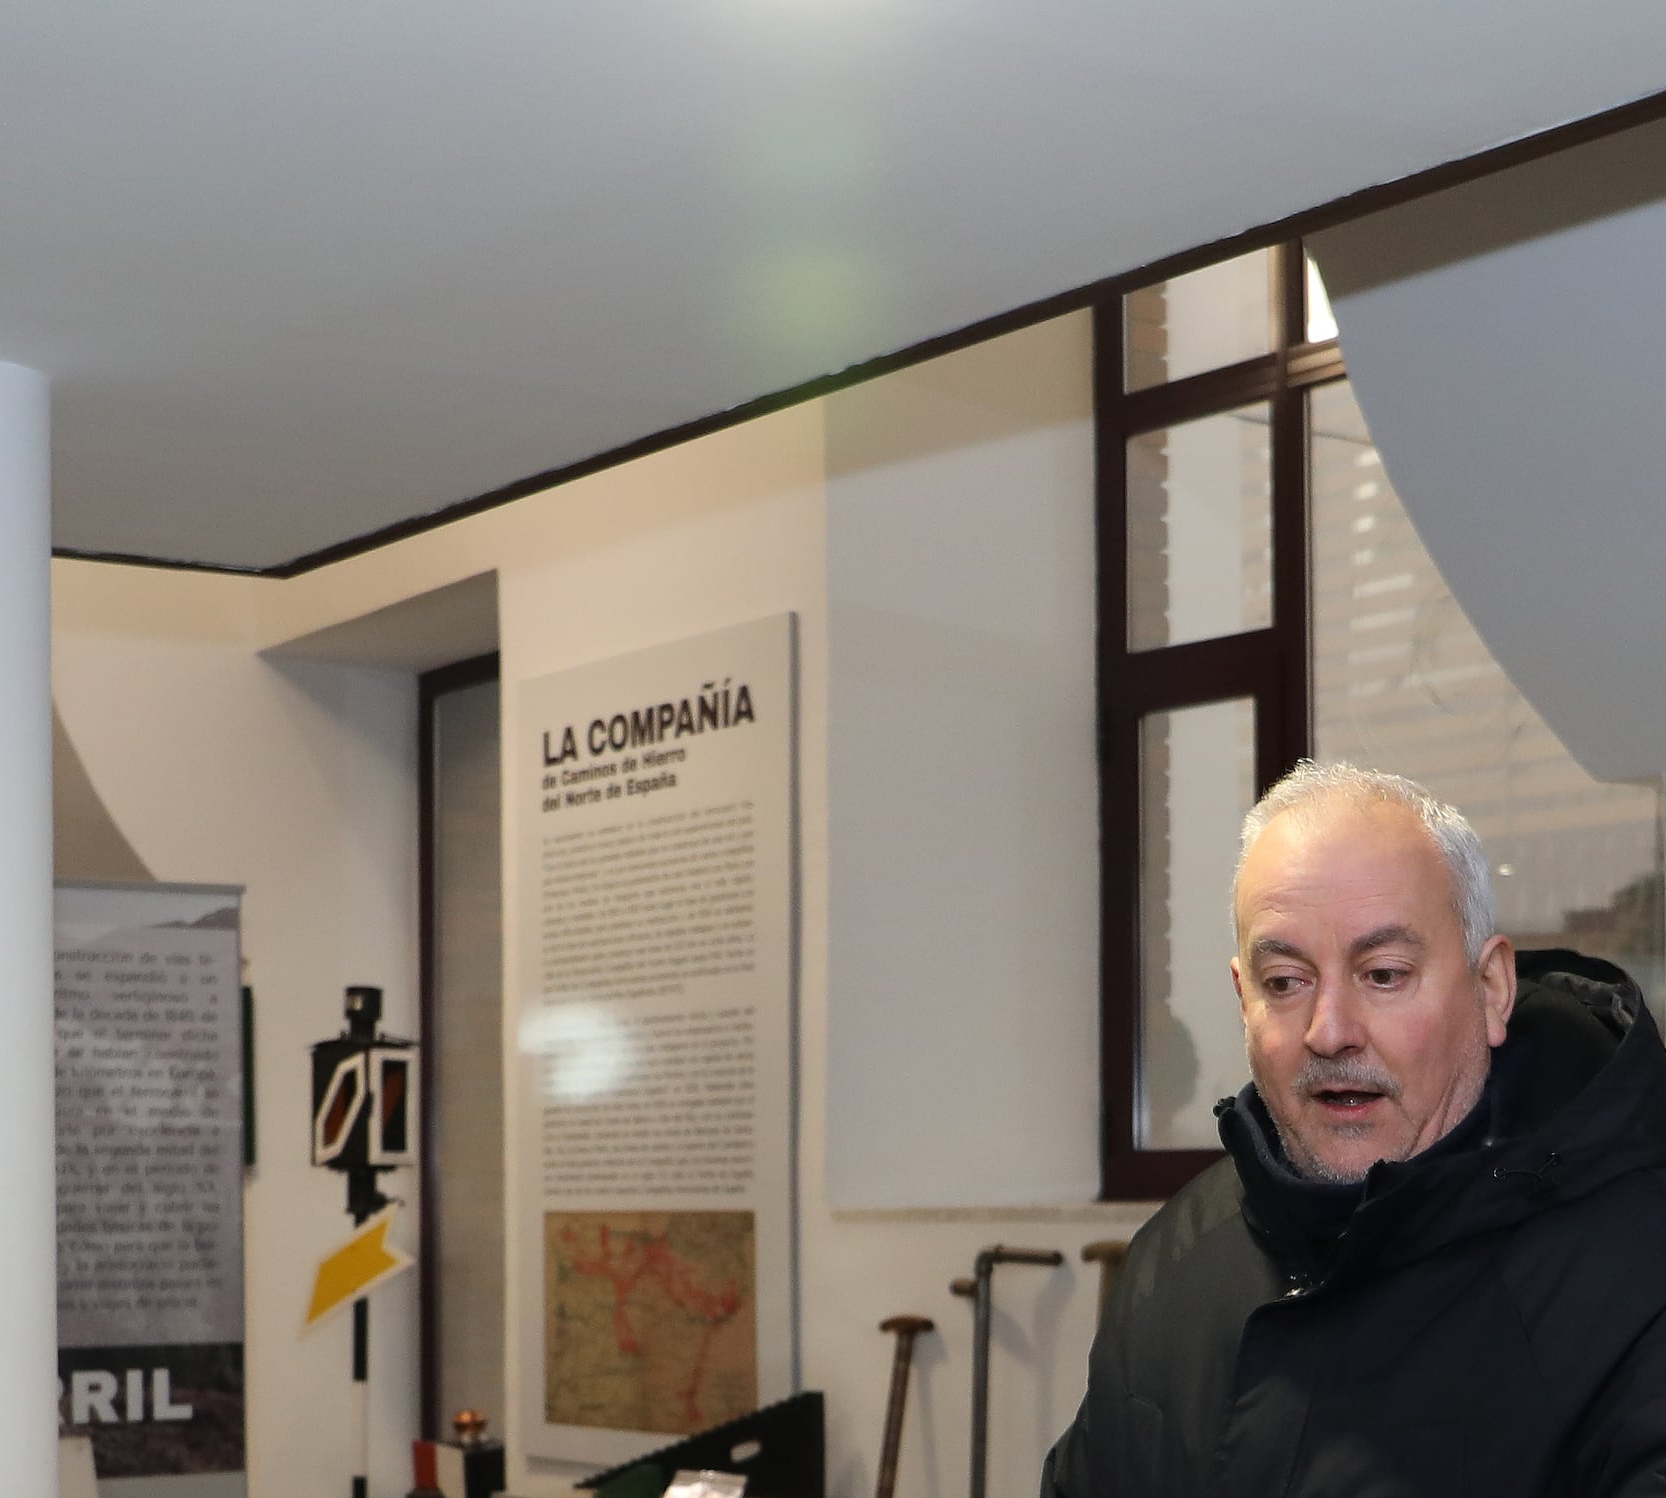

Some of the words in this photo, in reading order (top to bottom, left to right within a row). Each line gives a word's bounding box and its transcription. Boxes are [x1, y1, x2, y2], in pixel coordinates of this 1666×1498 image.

[543, 727, 578, 767] LA
[587, 677, 755, 756] COMPAÑÍA
[543, 775, 556, 790] de
[562, 763, 617, 786] Caminos
[622, 757, 637, 773] de
[643, 748, 686, 769] Hierro
[542, 796, 561, 813] del
[565, 788, 601, 808] Norte
[607, 784, 621, 800] de
[627, 772, 676, 797] España
